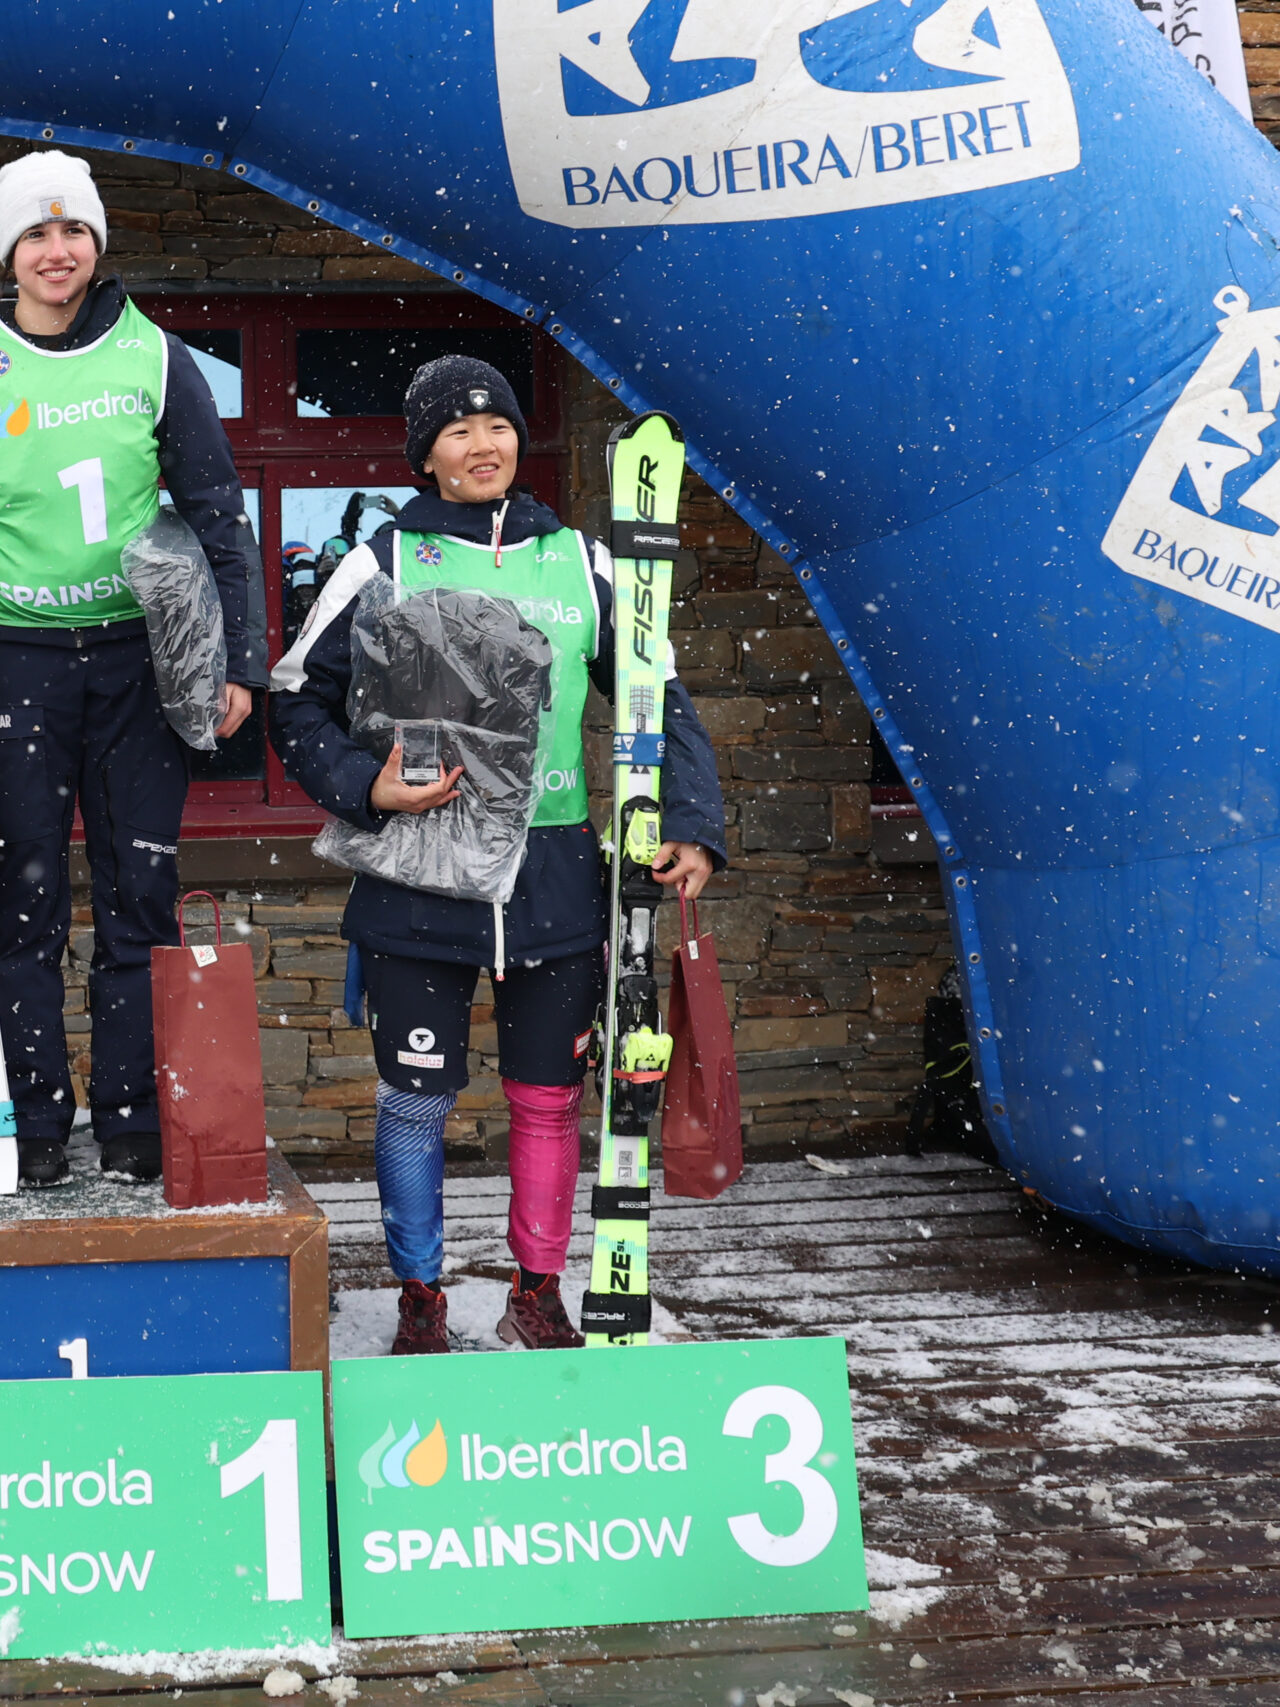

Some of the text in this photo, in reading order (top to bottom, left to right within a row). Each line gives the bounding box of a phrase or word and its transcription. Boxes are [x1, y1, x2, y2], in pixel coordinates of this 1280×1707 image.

[562, 100, 1032, 205] BAQUEIRA/BERET
[37, 388, 152, 429] Iberdrola
[57, 457, 108, 545] 1
[633, 455, 658, 666] FISCER
[1132, 528, 1280, 610] BAQUEIR
[399, 1053, 442, 1067] holaluz
[58, 1338, 87, 1379] 1
[220, 1419, 302, 1600] 1
[461, 1385, 838, 1567] Iberdrola 3
[363, 1515, 692, 1574] SPAINSNOW
